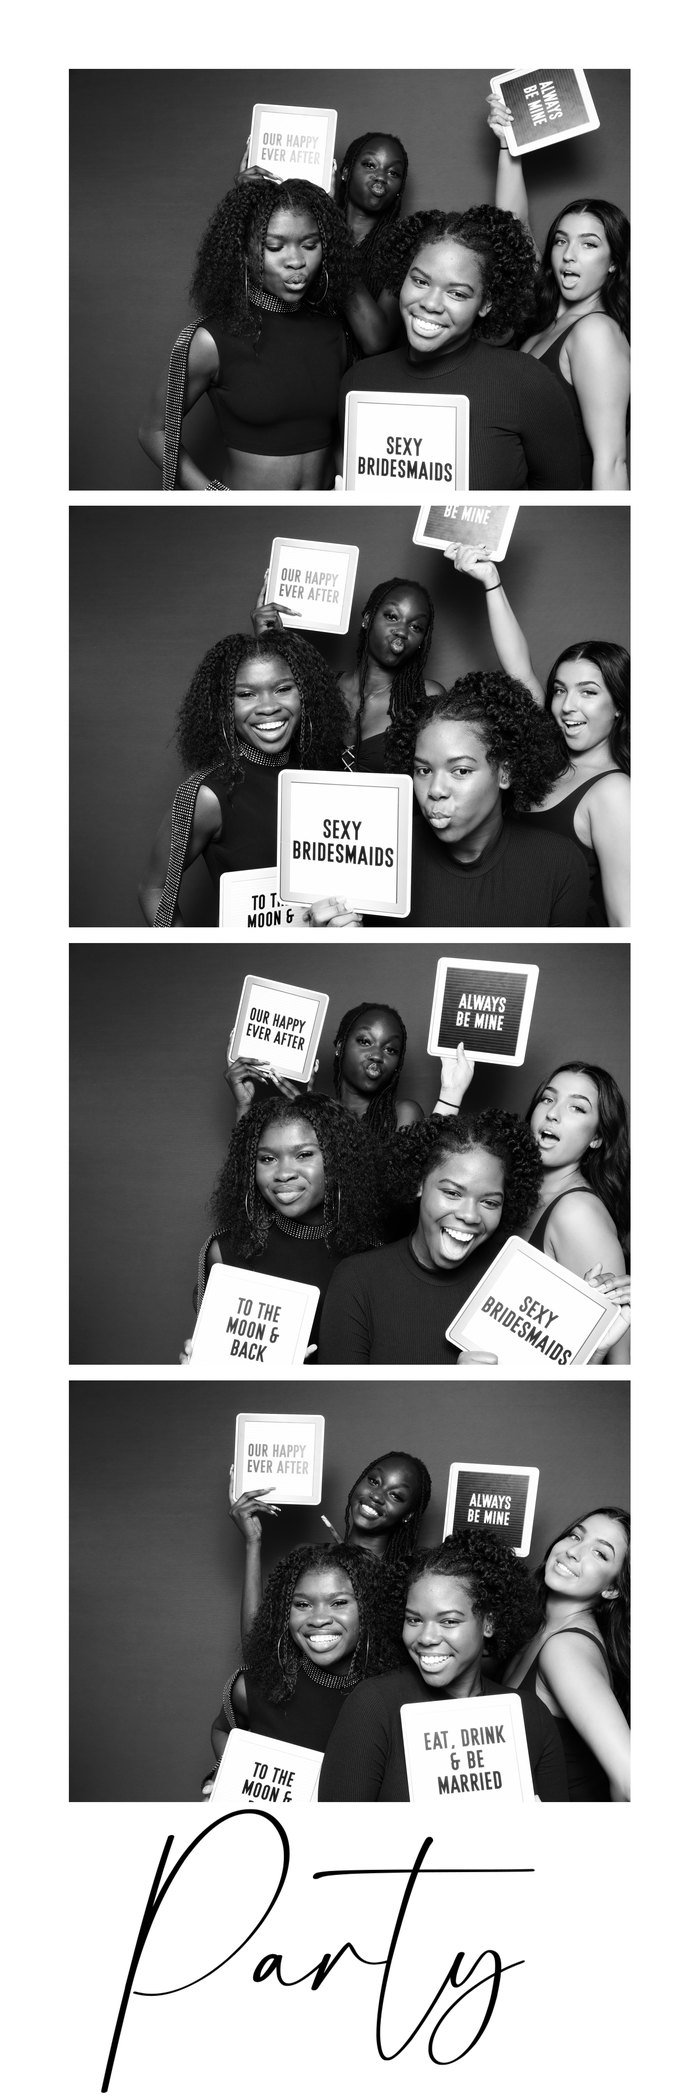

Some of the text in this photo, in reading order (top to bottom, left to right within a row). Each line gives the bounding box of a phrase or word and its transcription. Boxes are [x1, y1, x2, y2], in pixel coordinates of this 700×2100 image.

[524, 85, 547, 127] BE MINE
[539, 80, 563, 120] ALWAYS
[262, 132, 318, 149] OUR HAPPY
[261, 147, 320, 165] EVER AFTER
[386, 436, 423, 456] SEXY
[358, 456, 452, 482] BRIDESMAIDS
[444, 505, 490, 524] BE MINE
[281, 568, 338, 587] OUR HAPPY
[279, 583, 339, 604] EVER AFTER
[323, 819, 362, 840] SEXY
[292, 841, 394, 867] BRIDESMAIDS
[251, 893, 266, 910] TO
[247, 908, 294, 927] MOON &
[458, 993, 507, 1012] ALWAYS
[249, 1007, 306, 1033] OUR HAPPY
[456, 1011, 504, 1031] BE MINE
[246, 1022, 305, 1051] EVER AFTER
[236, 1297, 282, 1322] TO THE
[518, 1295, 559, 1330] SEXY
[226, 1317, 280, 1342] MOON &
[481, 1295, 572, 1365] BRIDESMAIDS
[229, 1339, 268, 1362] BACK
[248, 1443, 306, 1459] OUR HAPPY
[247, 1459, 309, 1475] EVER AFTER
[469, 1493, 512, 1510] ALWAYS
[467, 1508, 510, 1525] BE MINE
[424, 1725, 506, 1750] EAT, DRINK
[450, 1750, 485, 1770] & BE
[252, 1761, 296, 1787] TO THE
[437, 1772, 502, 1795] MARRIED
[241, 1779, 279, 1802] MOON
